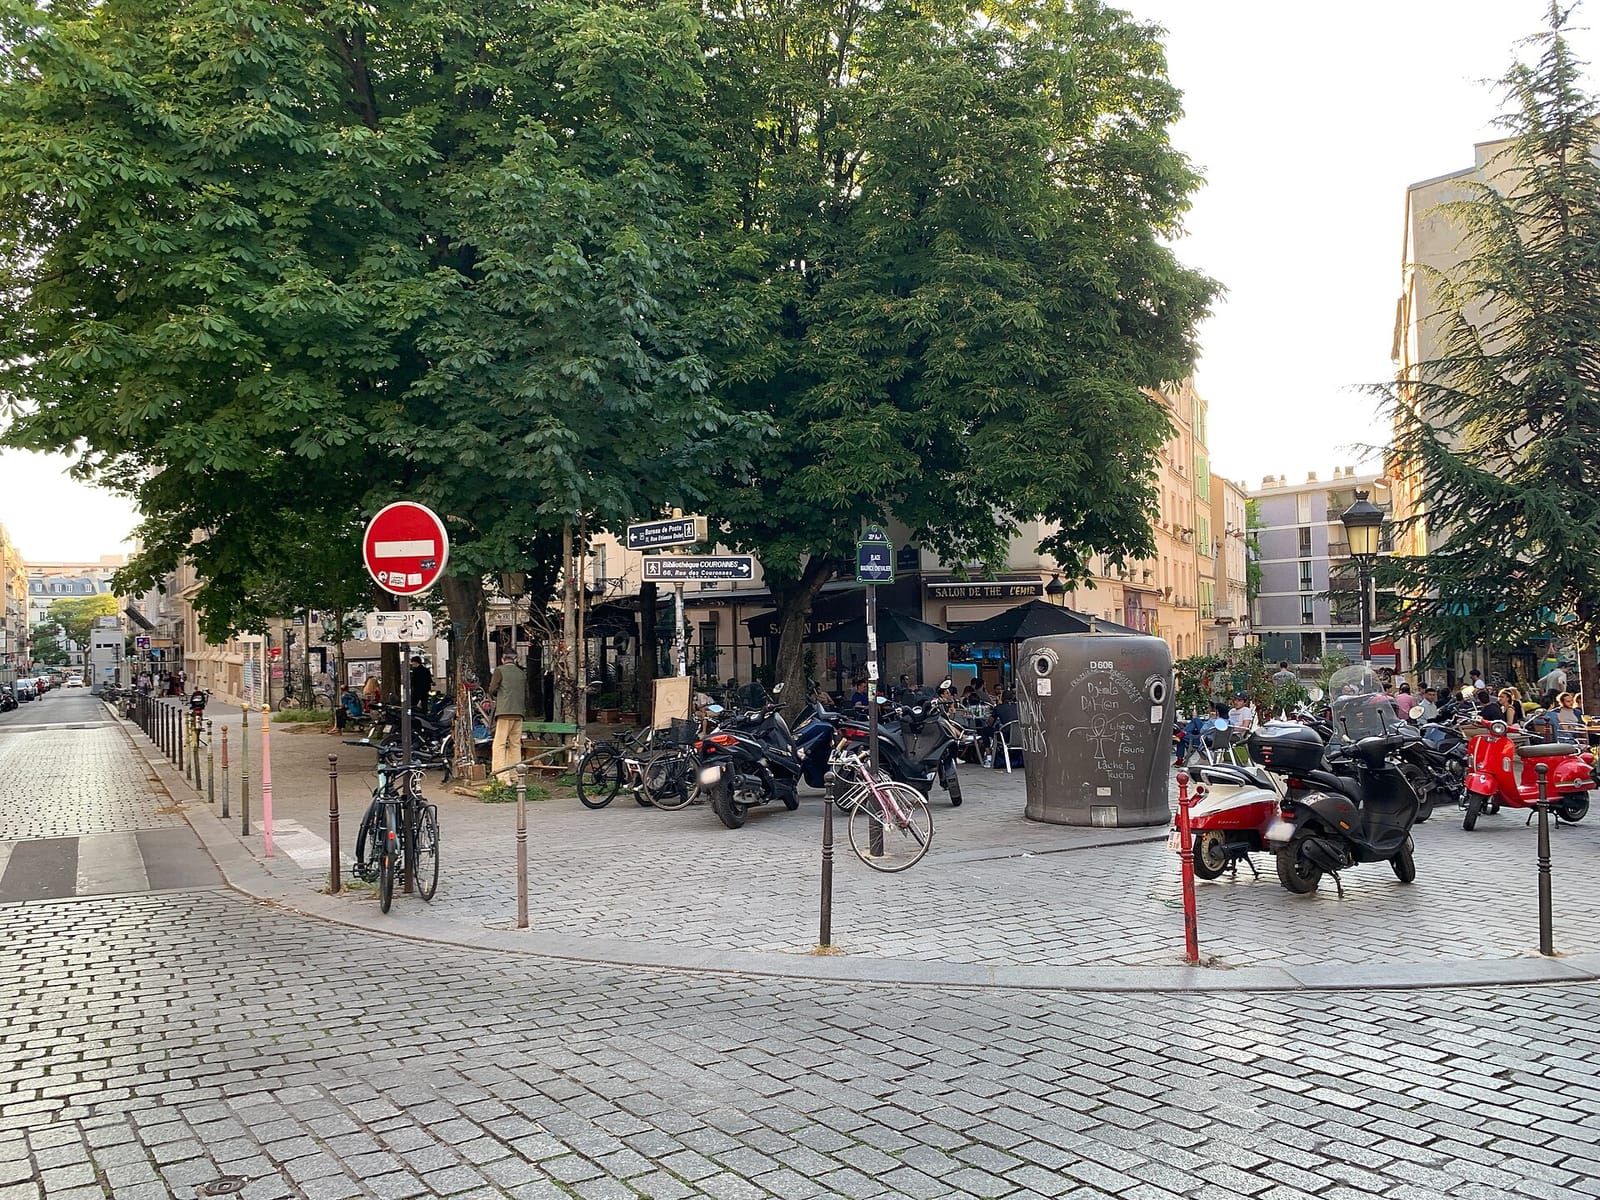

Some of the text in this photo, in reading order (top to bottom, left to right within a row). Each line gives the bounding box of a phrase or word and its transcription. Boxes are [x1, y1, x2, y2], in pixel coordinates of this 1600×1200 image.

[662, 561, 699, 569] Bibliothèque
[935, 587, 966, 598] SALON
[968, 587, 981, 597] DE
